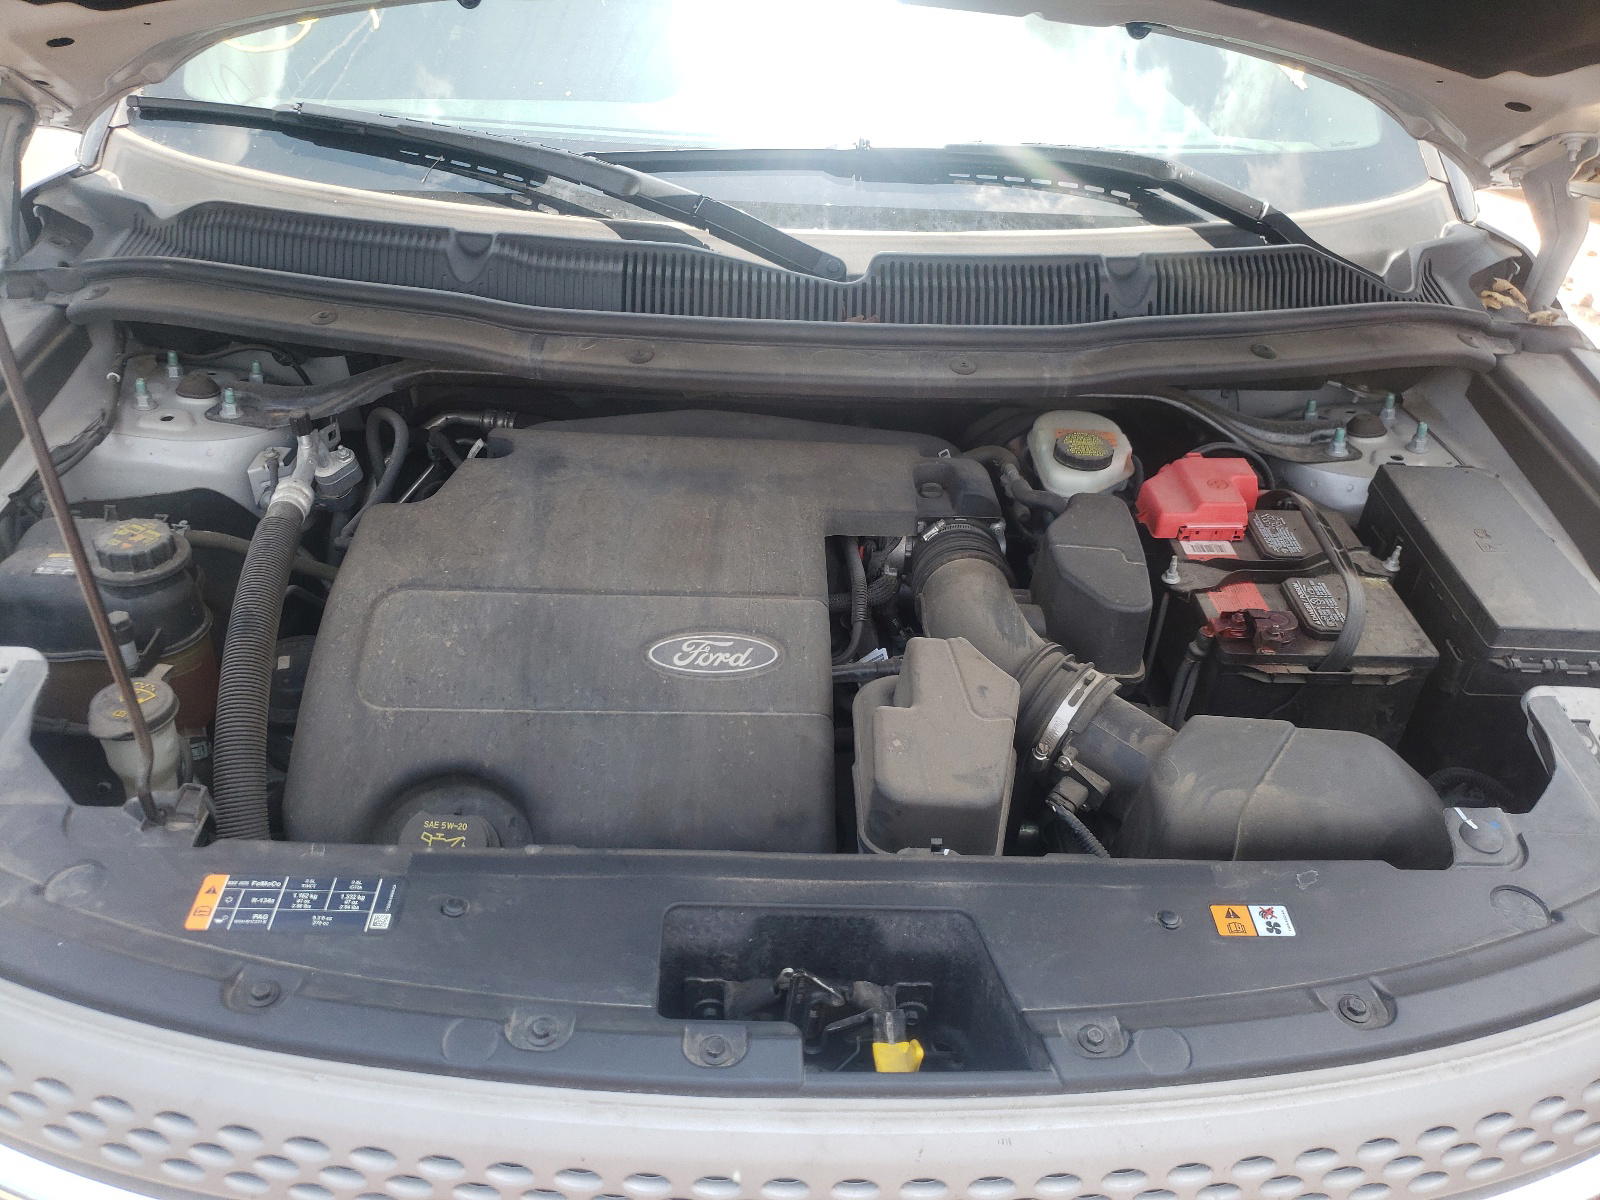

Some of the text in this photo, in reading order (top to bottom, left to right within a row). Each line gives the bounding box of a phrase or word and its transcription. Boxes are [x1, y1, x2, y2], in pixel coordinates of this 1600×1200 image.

[673, 639, 754, 667] Ford
[424, 820, 468, 831] SAE 5W-20
